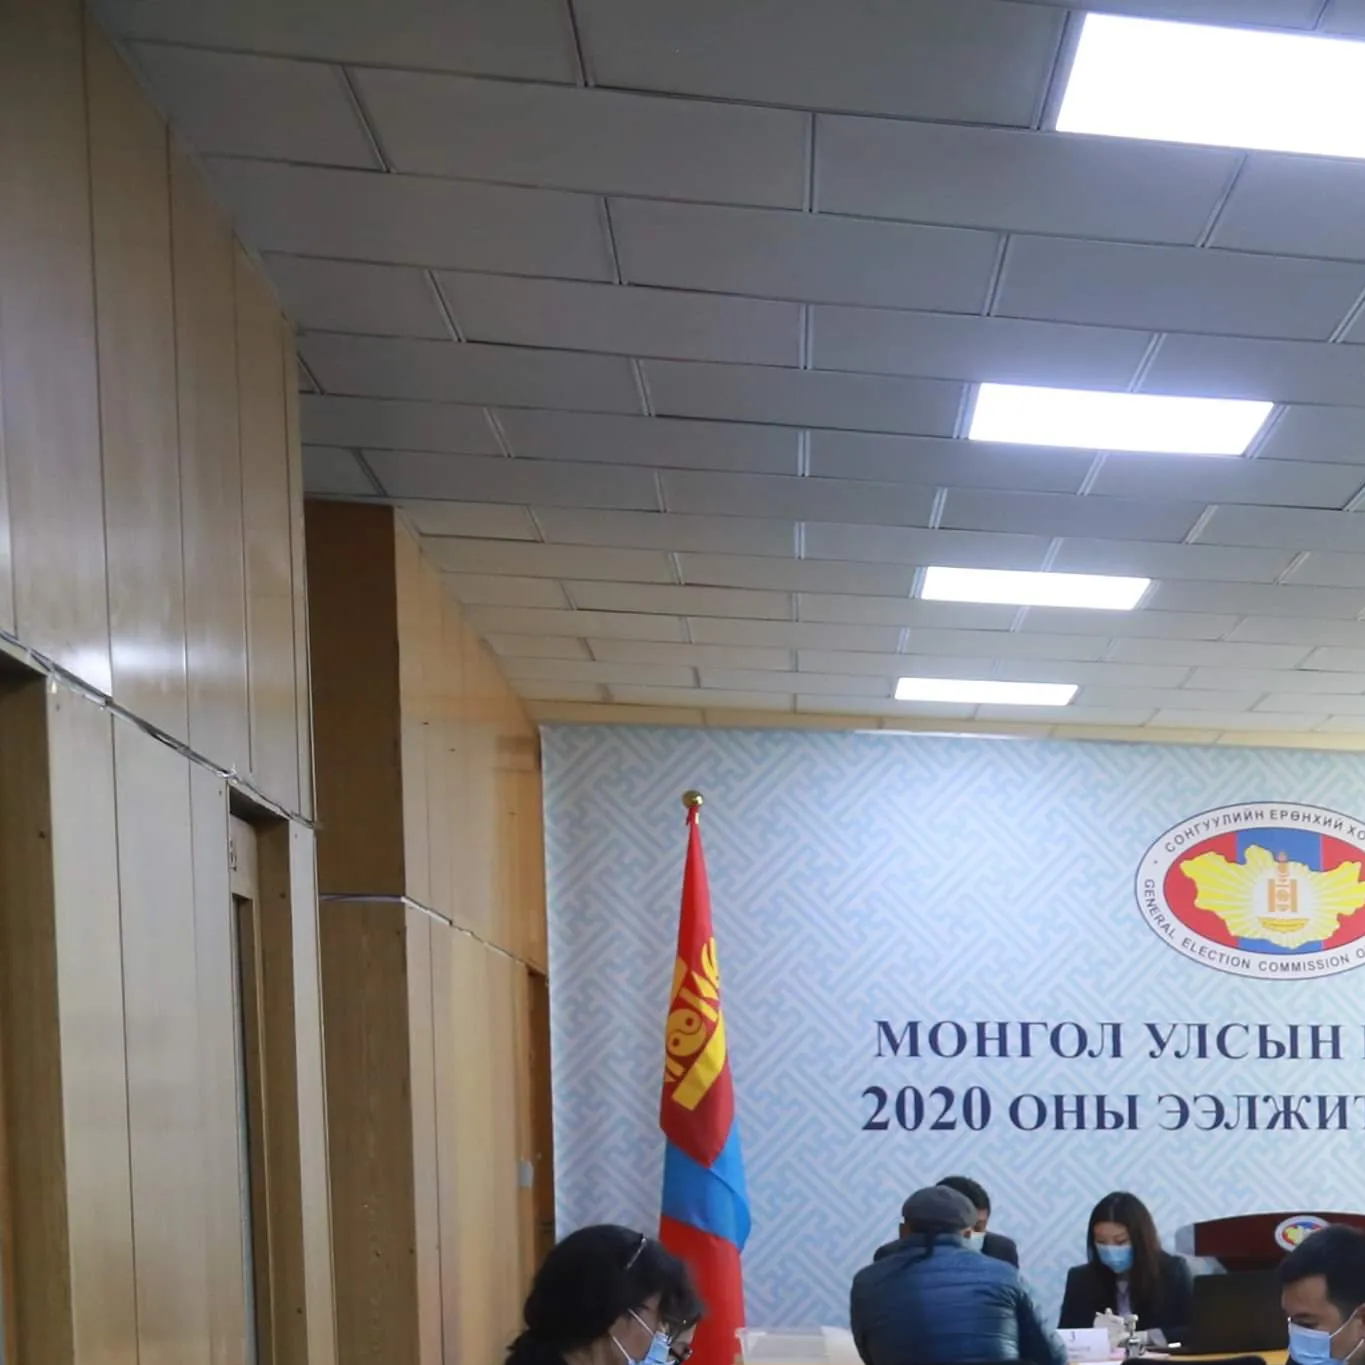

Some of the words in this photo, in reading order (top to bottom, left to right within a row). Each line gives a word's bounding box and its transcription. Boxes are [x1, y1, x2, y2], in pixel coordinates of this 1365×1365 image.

[1164, 809, 1264, 853] СОНГУУЛИЙН
[1270, 808, 1343, 831] ЕРӨНХИЙ
[1144, 878, 1175, 940] GENERAL
[1181, 937, 1250, 969] ELECTION
[1258, 954, 1350, 973] COMMISSION
[874, 1020, 1124, 1058] МОНГОЛ
[1144, 1023, 1344, 1060] УЛСЫН
[861, 1086, 991, 1131] 2020
[1009, 1093, 1140, 1131] ОНЫ
